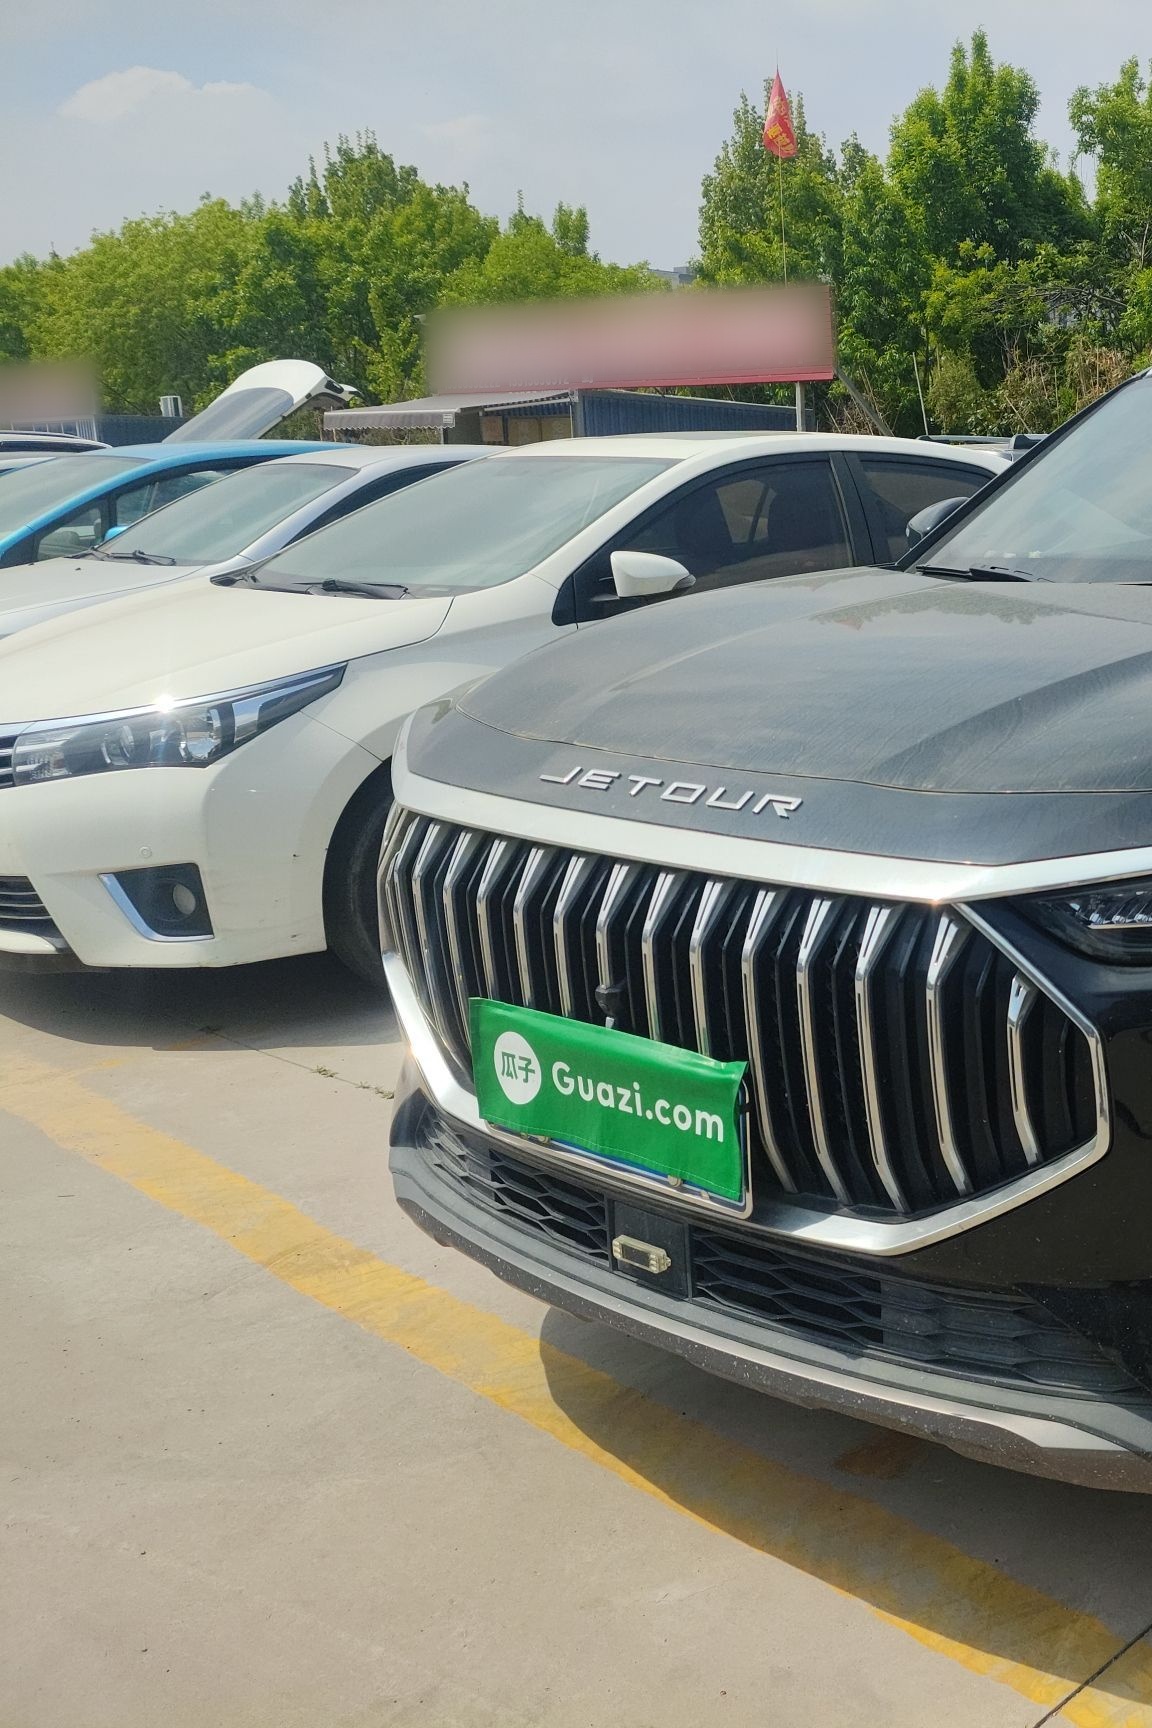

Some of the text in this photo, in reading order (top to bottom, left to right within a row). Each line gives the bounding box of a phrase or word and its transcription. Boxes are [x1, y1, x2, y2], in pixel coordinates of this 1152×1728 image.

[538, 766, 802, 819] JETOUR
[501, 1051, 536, 1084] 瓜子
[551, 1061, 725, 1143] Guazi.com
